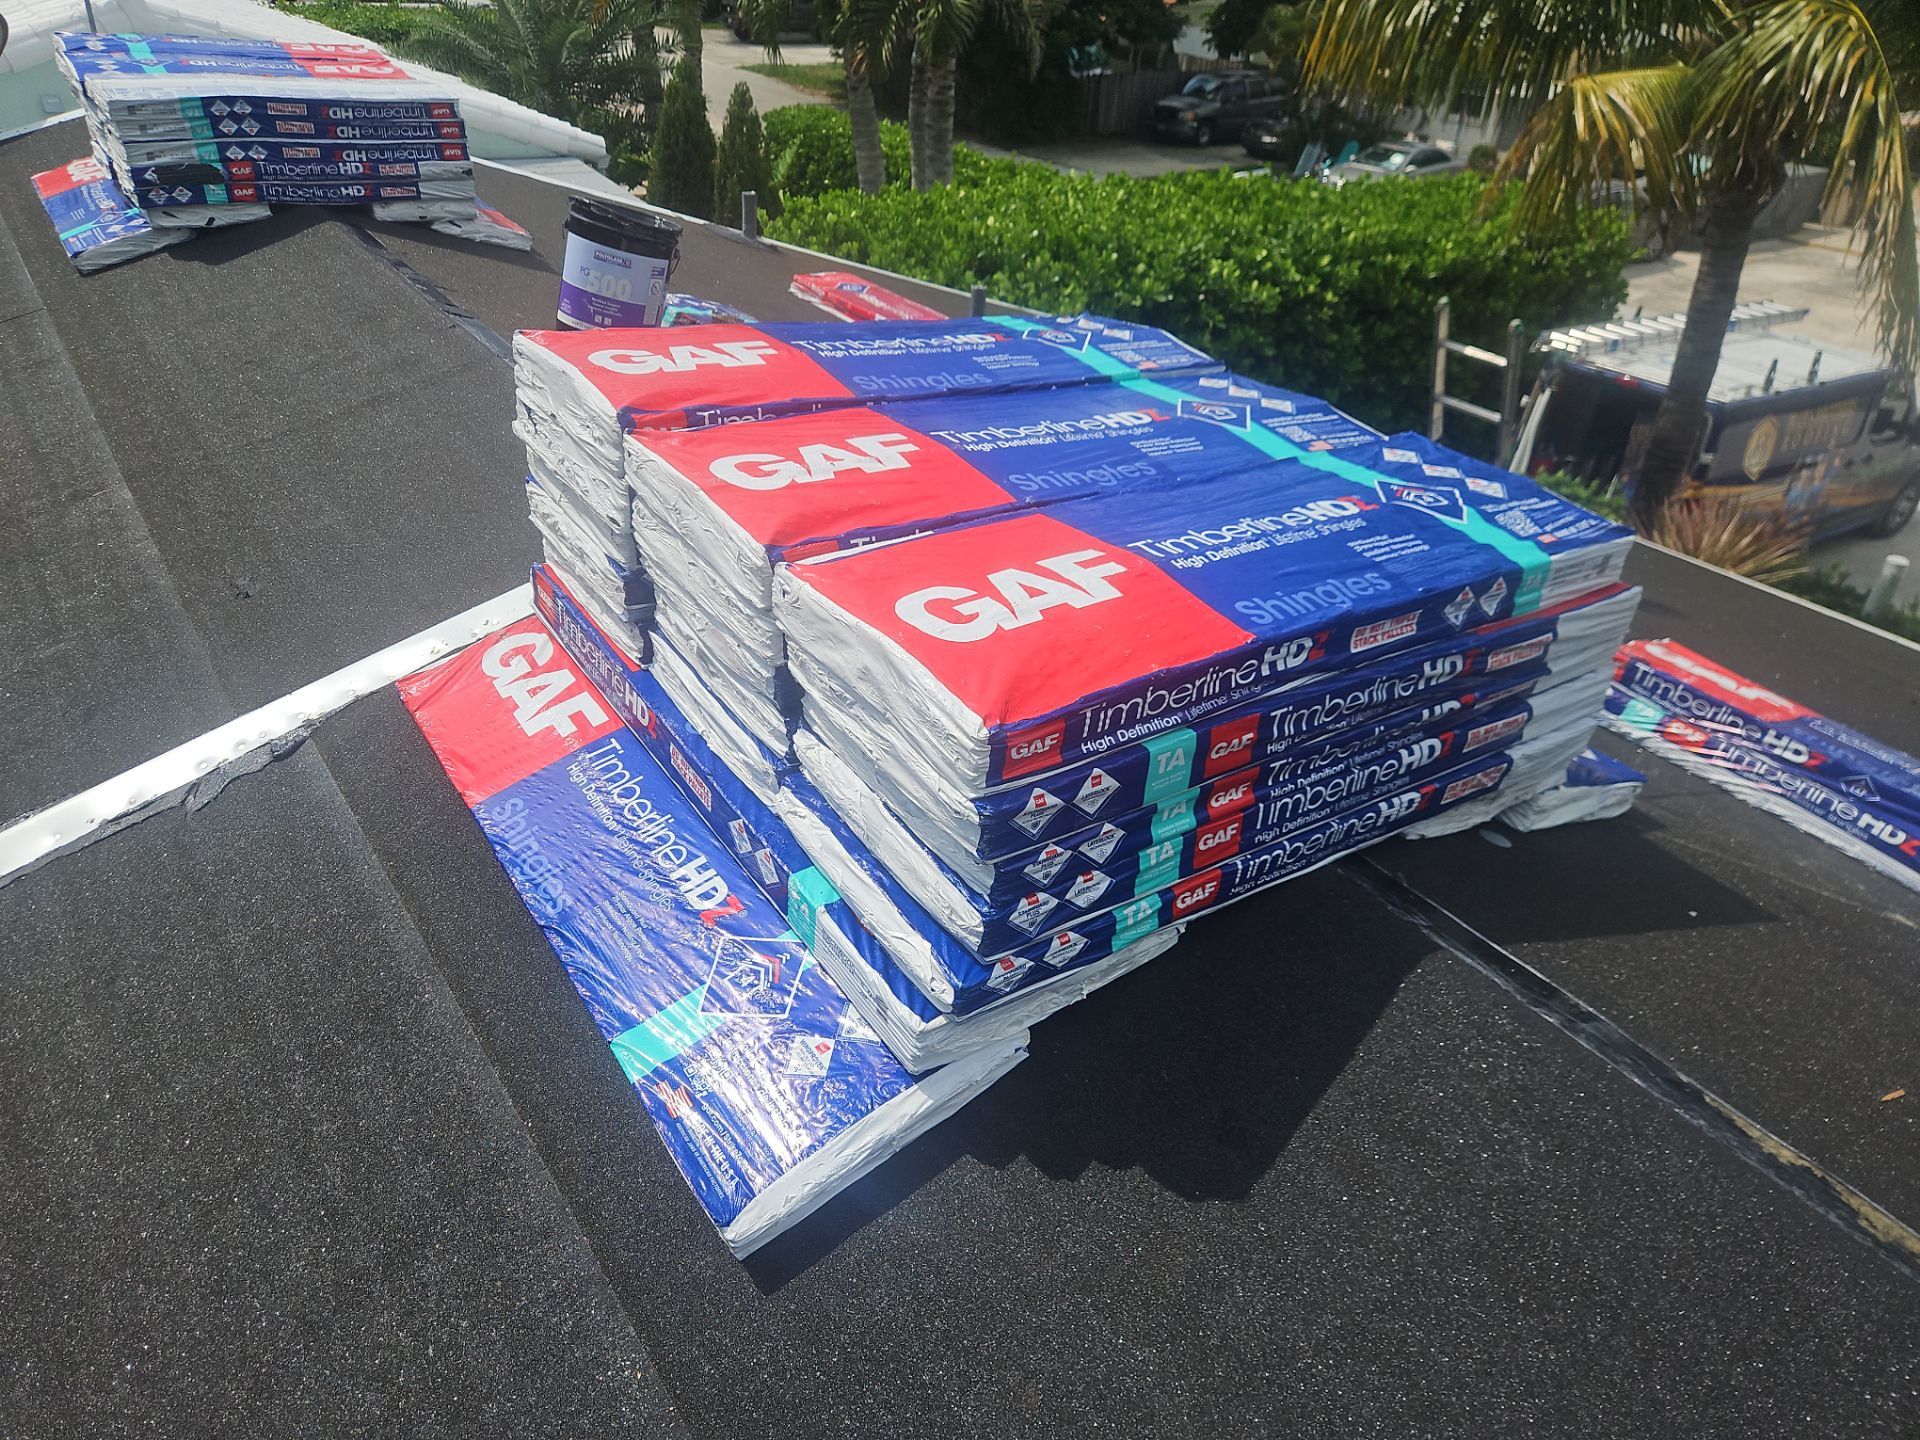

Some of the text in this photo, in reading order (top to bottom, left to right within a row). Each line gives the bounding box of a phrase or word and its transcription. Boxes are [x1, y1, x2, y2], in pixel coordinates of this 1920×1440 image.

[232, 167, 252, 175] GAF
[234, 188, 254, 196] GAF
[586, 270, 632, 300] 500
[587, 340, 778, 375] GAF
[851, 371, 993, 392] Shingles
[963, 438, 998, 452] High
[708, 432, 921, 491] GAF
[1008, 460, 1157, 492] Shingles
[1170, 550, 1210, 570] High
[895, 549, 1128, 642] GAF
[1233, 573, 1392, 626] Shingles
[1352, 624, 1416, 649] STACK PALLETS
[1354, 626, 1368, 638] DO
[1369, 621, 1388, 634] NOT
[481, 632, 609, 738] GAF
[1081, 734, 1116, 754] High
[1670, 721, 1706, 742] GAF
[1010, 731, 1060, 760] GAF
[1210, 732, 1254, 760] GAF
[1266, 737, 1292, 754] High
[1157, 747, 1185, 774] TA
[566, 761, 589, 790] High
[1210, 781, 1251, 808] GAF
[1198, 823, 1239, 851] GAF
[492, 797, 570, 919] Shingles
[1147, 841, 1175, 866] TA
[1176, 880, 1218, 909] GAF
[1122, 901, 1153, 925] TA
[703, 1135, 717, 1149] IN
[709, 1146, 728, 1165] THE
